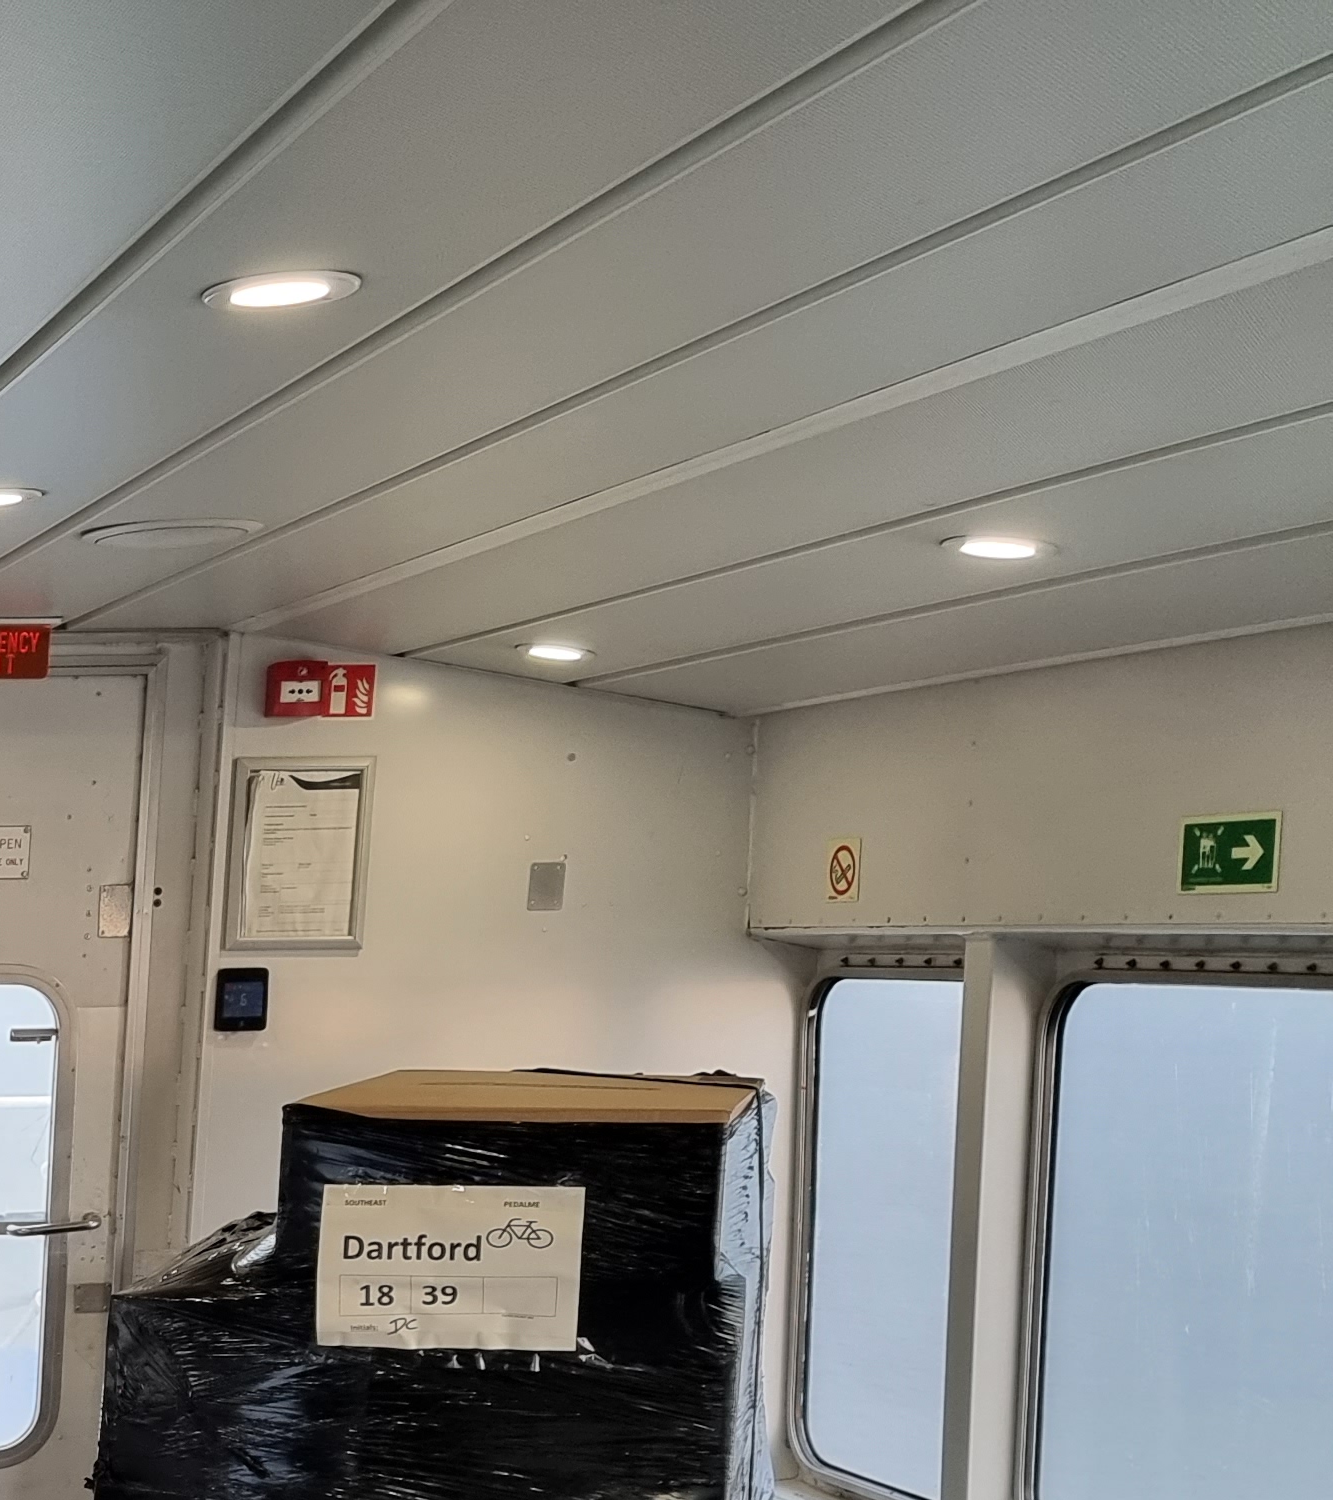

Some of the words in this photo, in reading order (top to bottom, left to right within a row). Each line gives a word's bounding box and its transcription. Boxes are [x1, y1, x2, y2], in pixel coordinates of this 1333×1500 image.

[5, 857, 24, 866] ONLY
[344, 1199, 387, 1207] SOUTHEAST
[342, 1234, 482, 1262] Dartford
[359, 1284, 395, 1307] 18
[421, 1284, 459, 1306] 39
